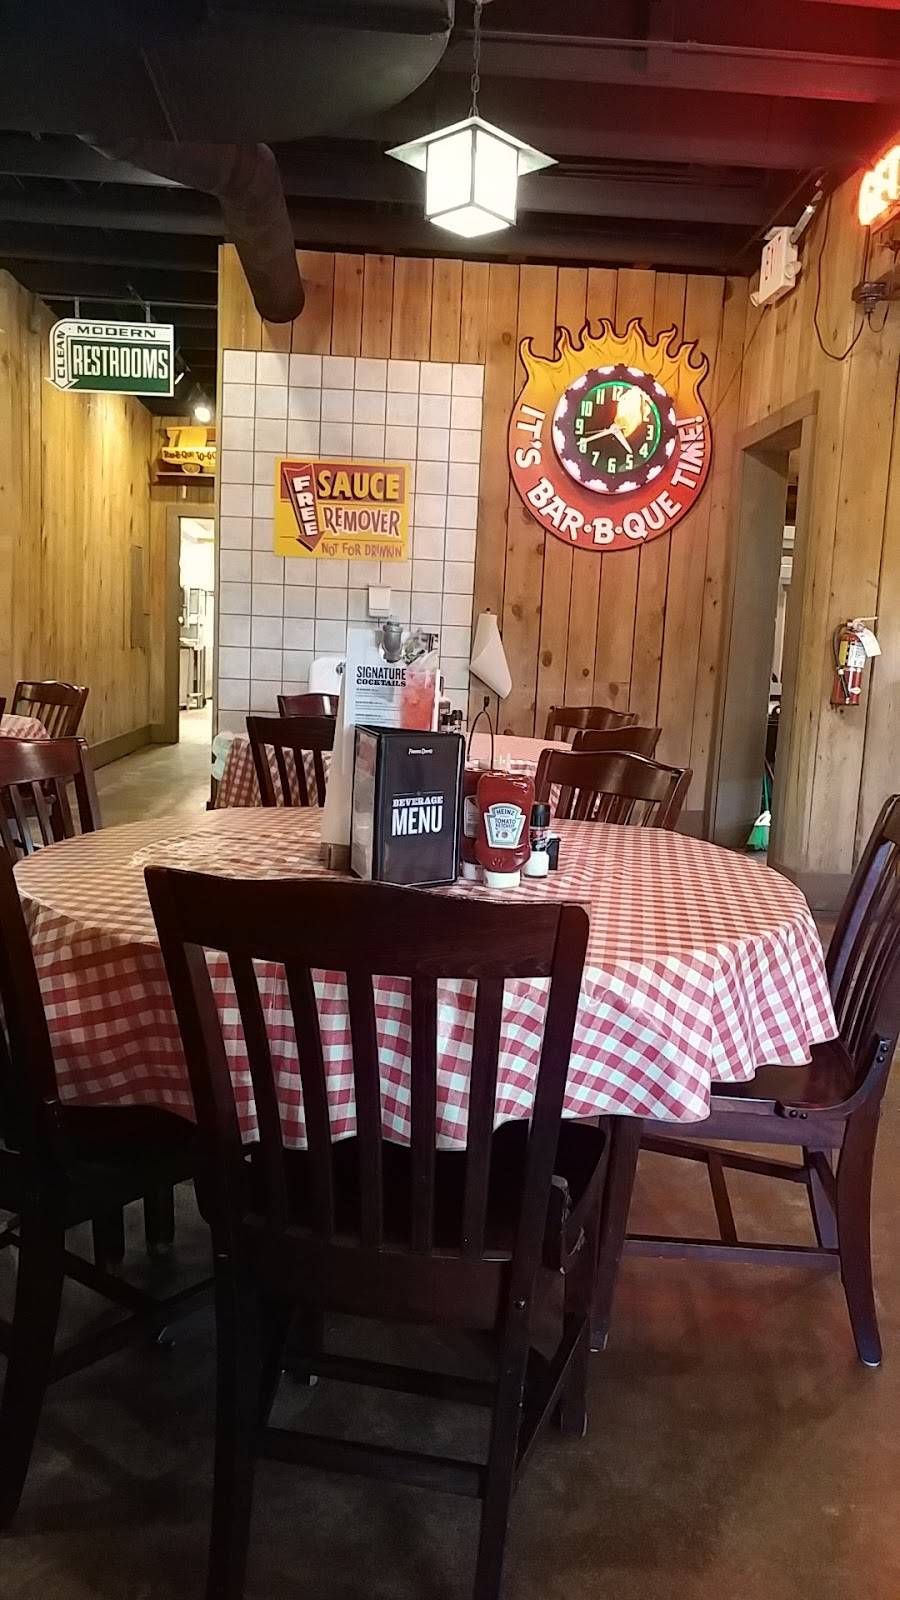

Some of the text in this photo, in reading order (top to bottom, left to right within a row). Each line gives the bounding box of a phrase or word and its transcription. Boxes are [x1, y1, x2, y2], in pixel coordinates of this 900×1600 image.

[77, 325, 156, 338] MODERN
[57, 330, 67, 378] CLEAN
[72, 344, 169, 379] RESTROOMS
[596, 389, 605, 405] 11
[581, 400, 593, 417] 10
[575, 418, 584, 435] 9
[646, 425, 654, 440] 3
[515, 404, 546, 468] IT'S
[670, 415, 704, 489] TIME!
[579, 438, 588, 454] 8
[639, 443, 649, 458] 4
[592, 451, 600, 466] 7
[607, 458, 616, 473] 6
[625, 454, 633, 470] 5
[318, 470, 400, 500] SAUCE
[293, 475, 319, 536] FREE
[323, 506, 400, 537] REMOVER
[321, 542, 338, 556] NOT
[342, 542, 361, 556] FOR
[356, 666, 407, 681] SIGNATURE
[356, 679, 407, 687] COCKTAILS
[392, 796, 444, 808] BEVERAGE
[496, 808, 515, 816] HEINZ
[392, 805, 443, 836] MENU
